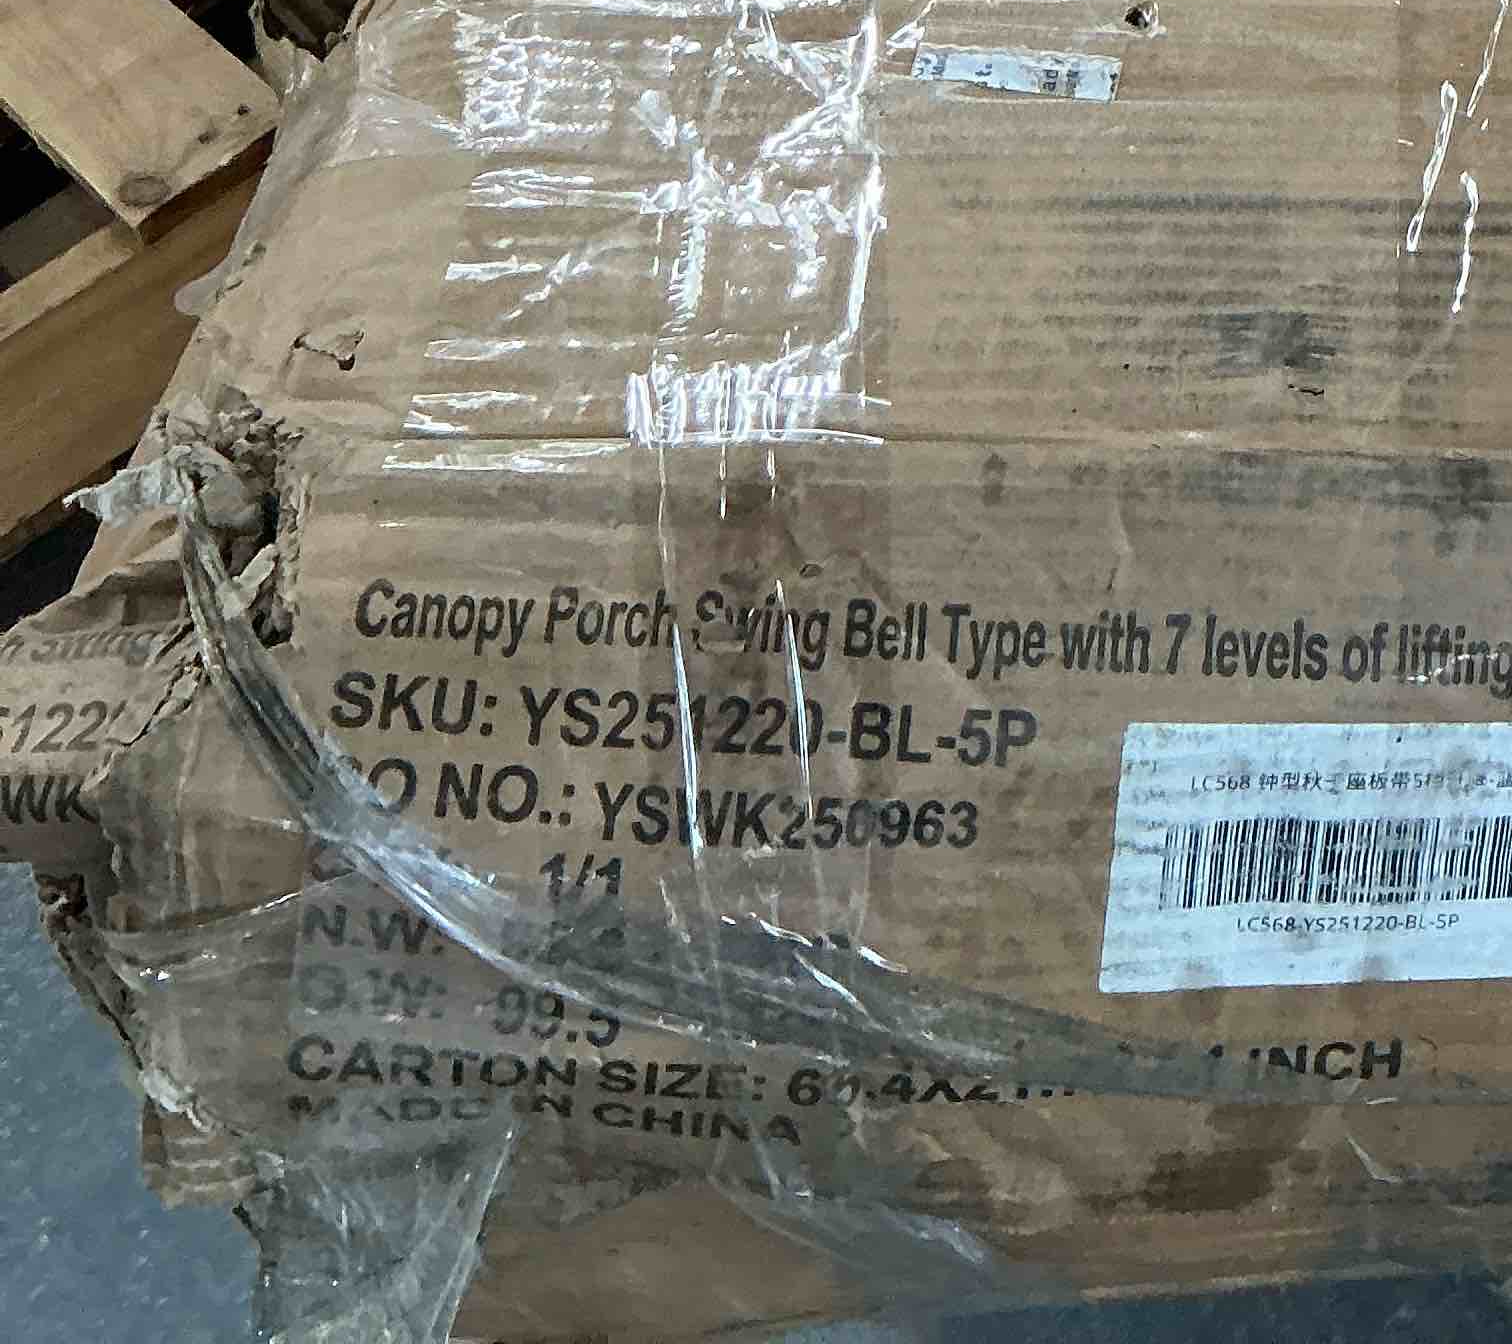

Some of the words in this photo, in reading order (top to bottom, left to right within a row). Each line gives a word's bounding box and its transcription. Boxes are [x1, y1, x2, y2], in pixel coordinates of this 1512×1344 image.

[355, 577, 535, 658] Canopy
[544, 584, 678, 648] Porch
[843, 597, 929, 662] Bell
[940, 602, 1047, 681] Type
[1060, 609, 1151, 675] with
[1165, 613, 1193, 676] 7
[1201, 613, 1329, 681] levels
[1342, 620, 1390, 683] of
[330, 671, 498, 737] SKU:
[518, 686, 1038, 768] YS251220-BL-5P
[433, 762, 576, 826] NO.:
[595, 781, 979, 852] YSWK250963
[540, 852, 624, 898] 1/1
[287, 1034, 579, 1089] CARTON
[599, 1060, 768, 1105] SIZE:
[592, 1103, 801, 1147] CHINA
